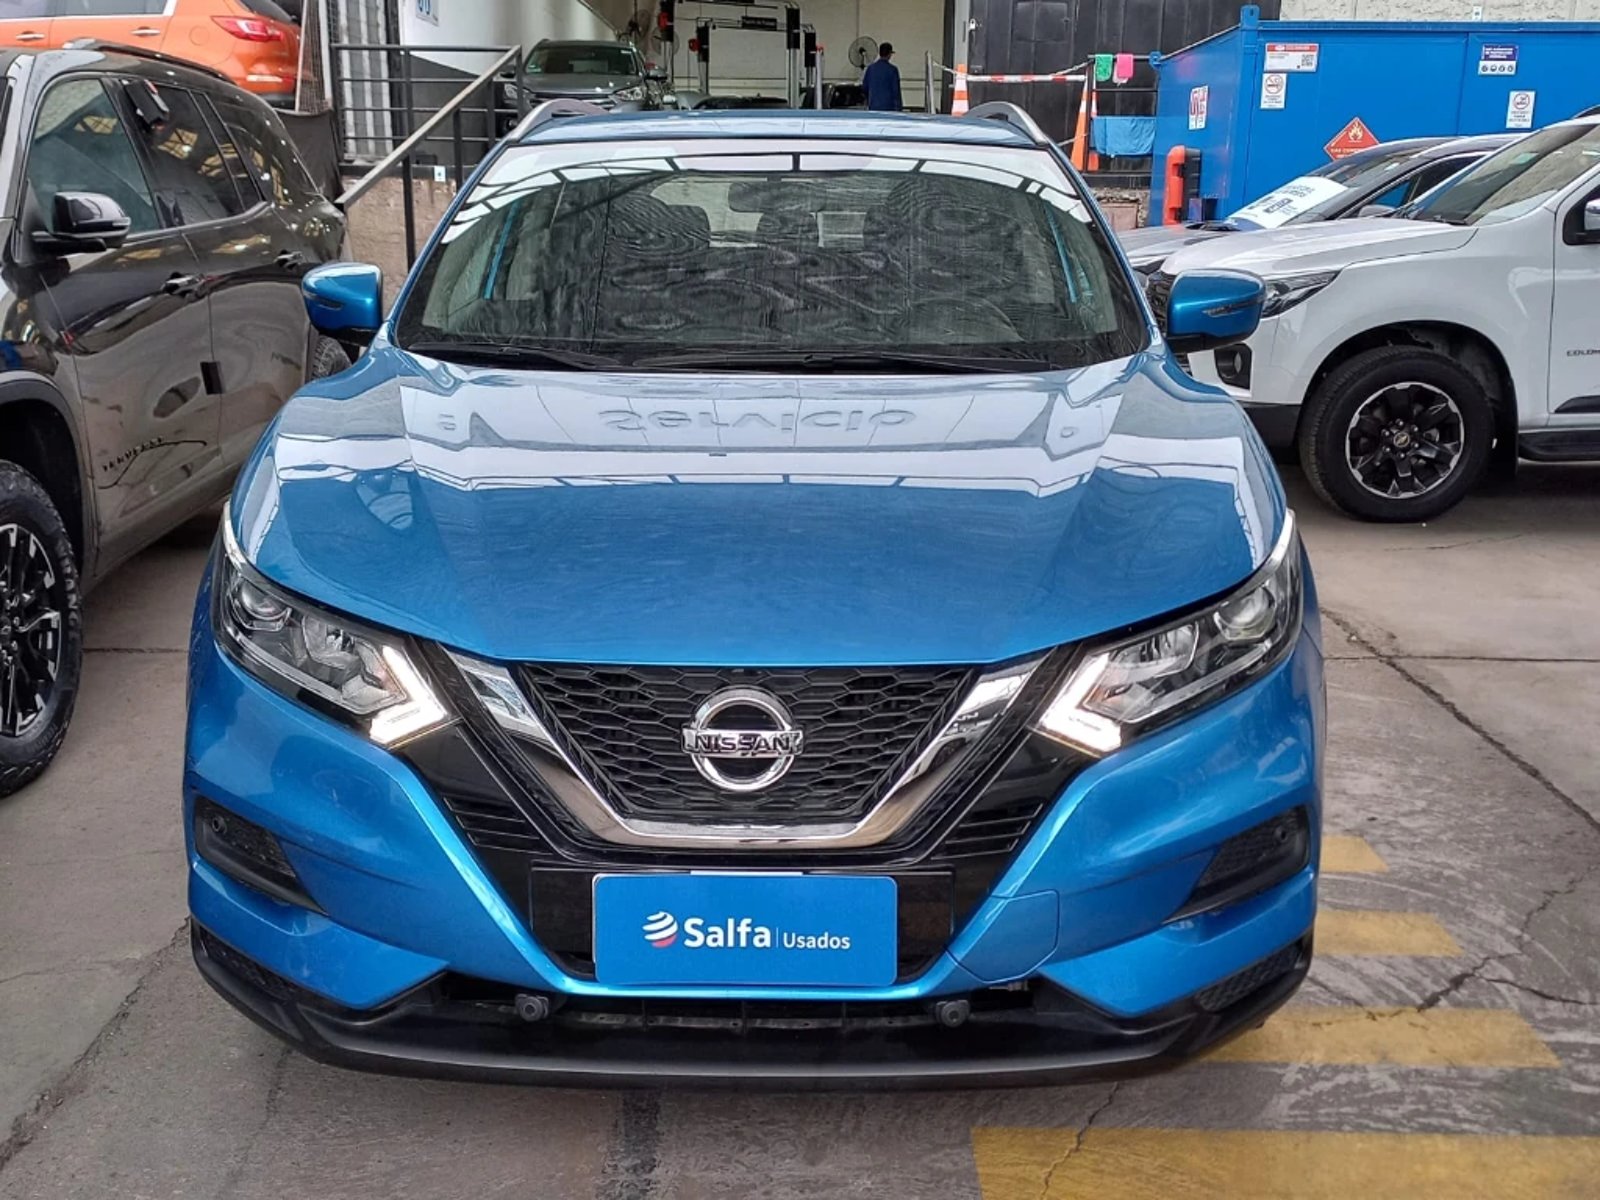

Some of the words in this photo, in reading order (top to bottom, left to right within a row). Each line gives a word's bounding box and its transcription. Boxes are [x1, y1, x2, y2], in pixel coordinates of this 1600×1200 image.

[694, 734, 791, 752] NISSAN
[683, 917, 771, 948] Salfa
[783, 932, 851, 950] Usados
